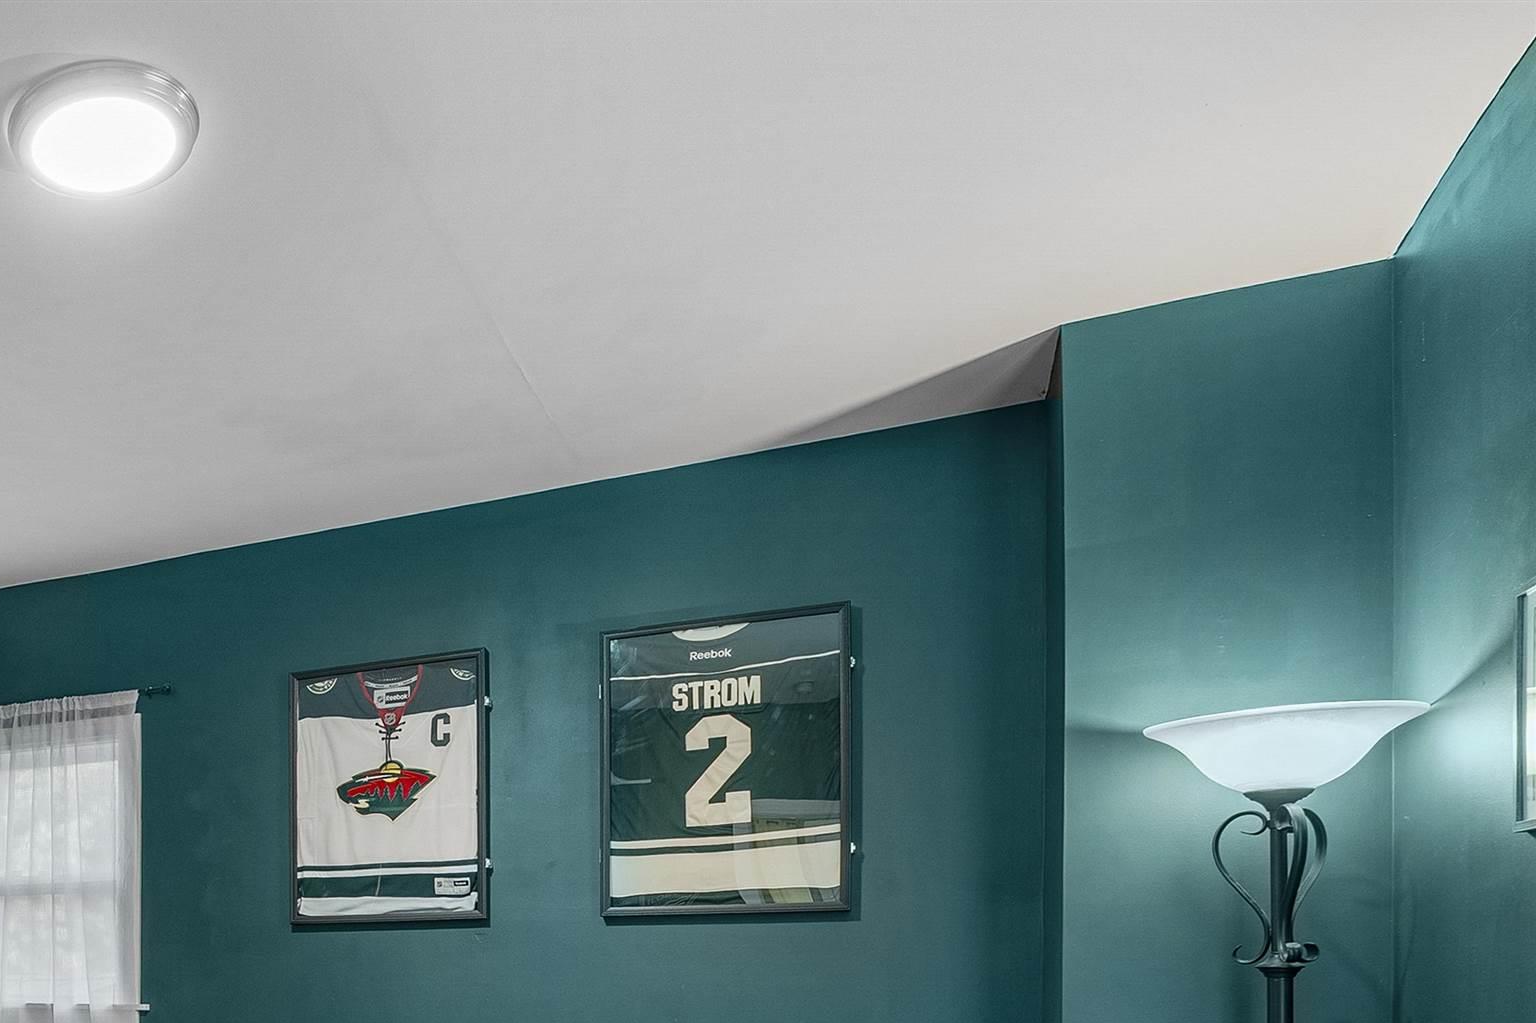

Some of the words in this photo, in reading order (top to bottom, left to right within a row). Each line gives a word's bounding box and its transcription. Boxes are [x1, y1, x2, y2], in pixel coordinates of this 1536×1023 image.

[689, 647, 732, 662] Reebok
[385, 693, 409, 702] Reebok
[672, 675, 761, 712] STROM
[430, 712, 451, 747] C
[685, 714, 752, 828] 2
